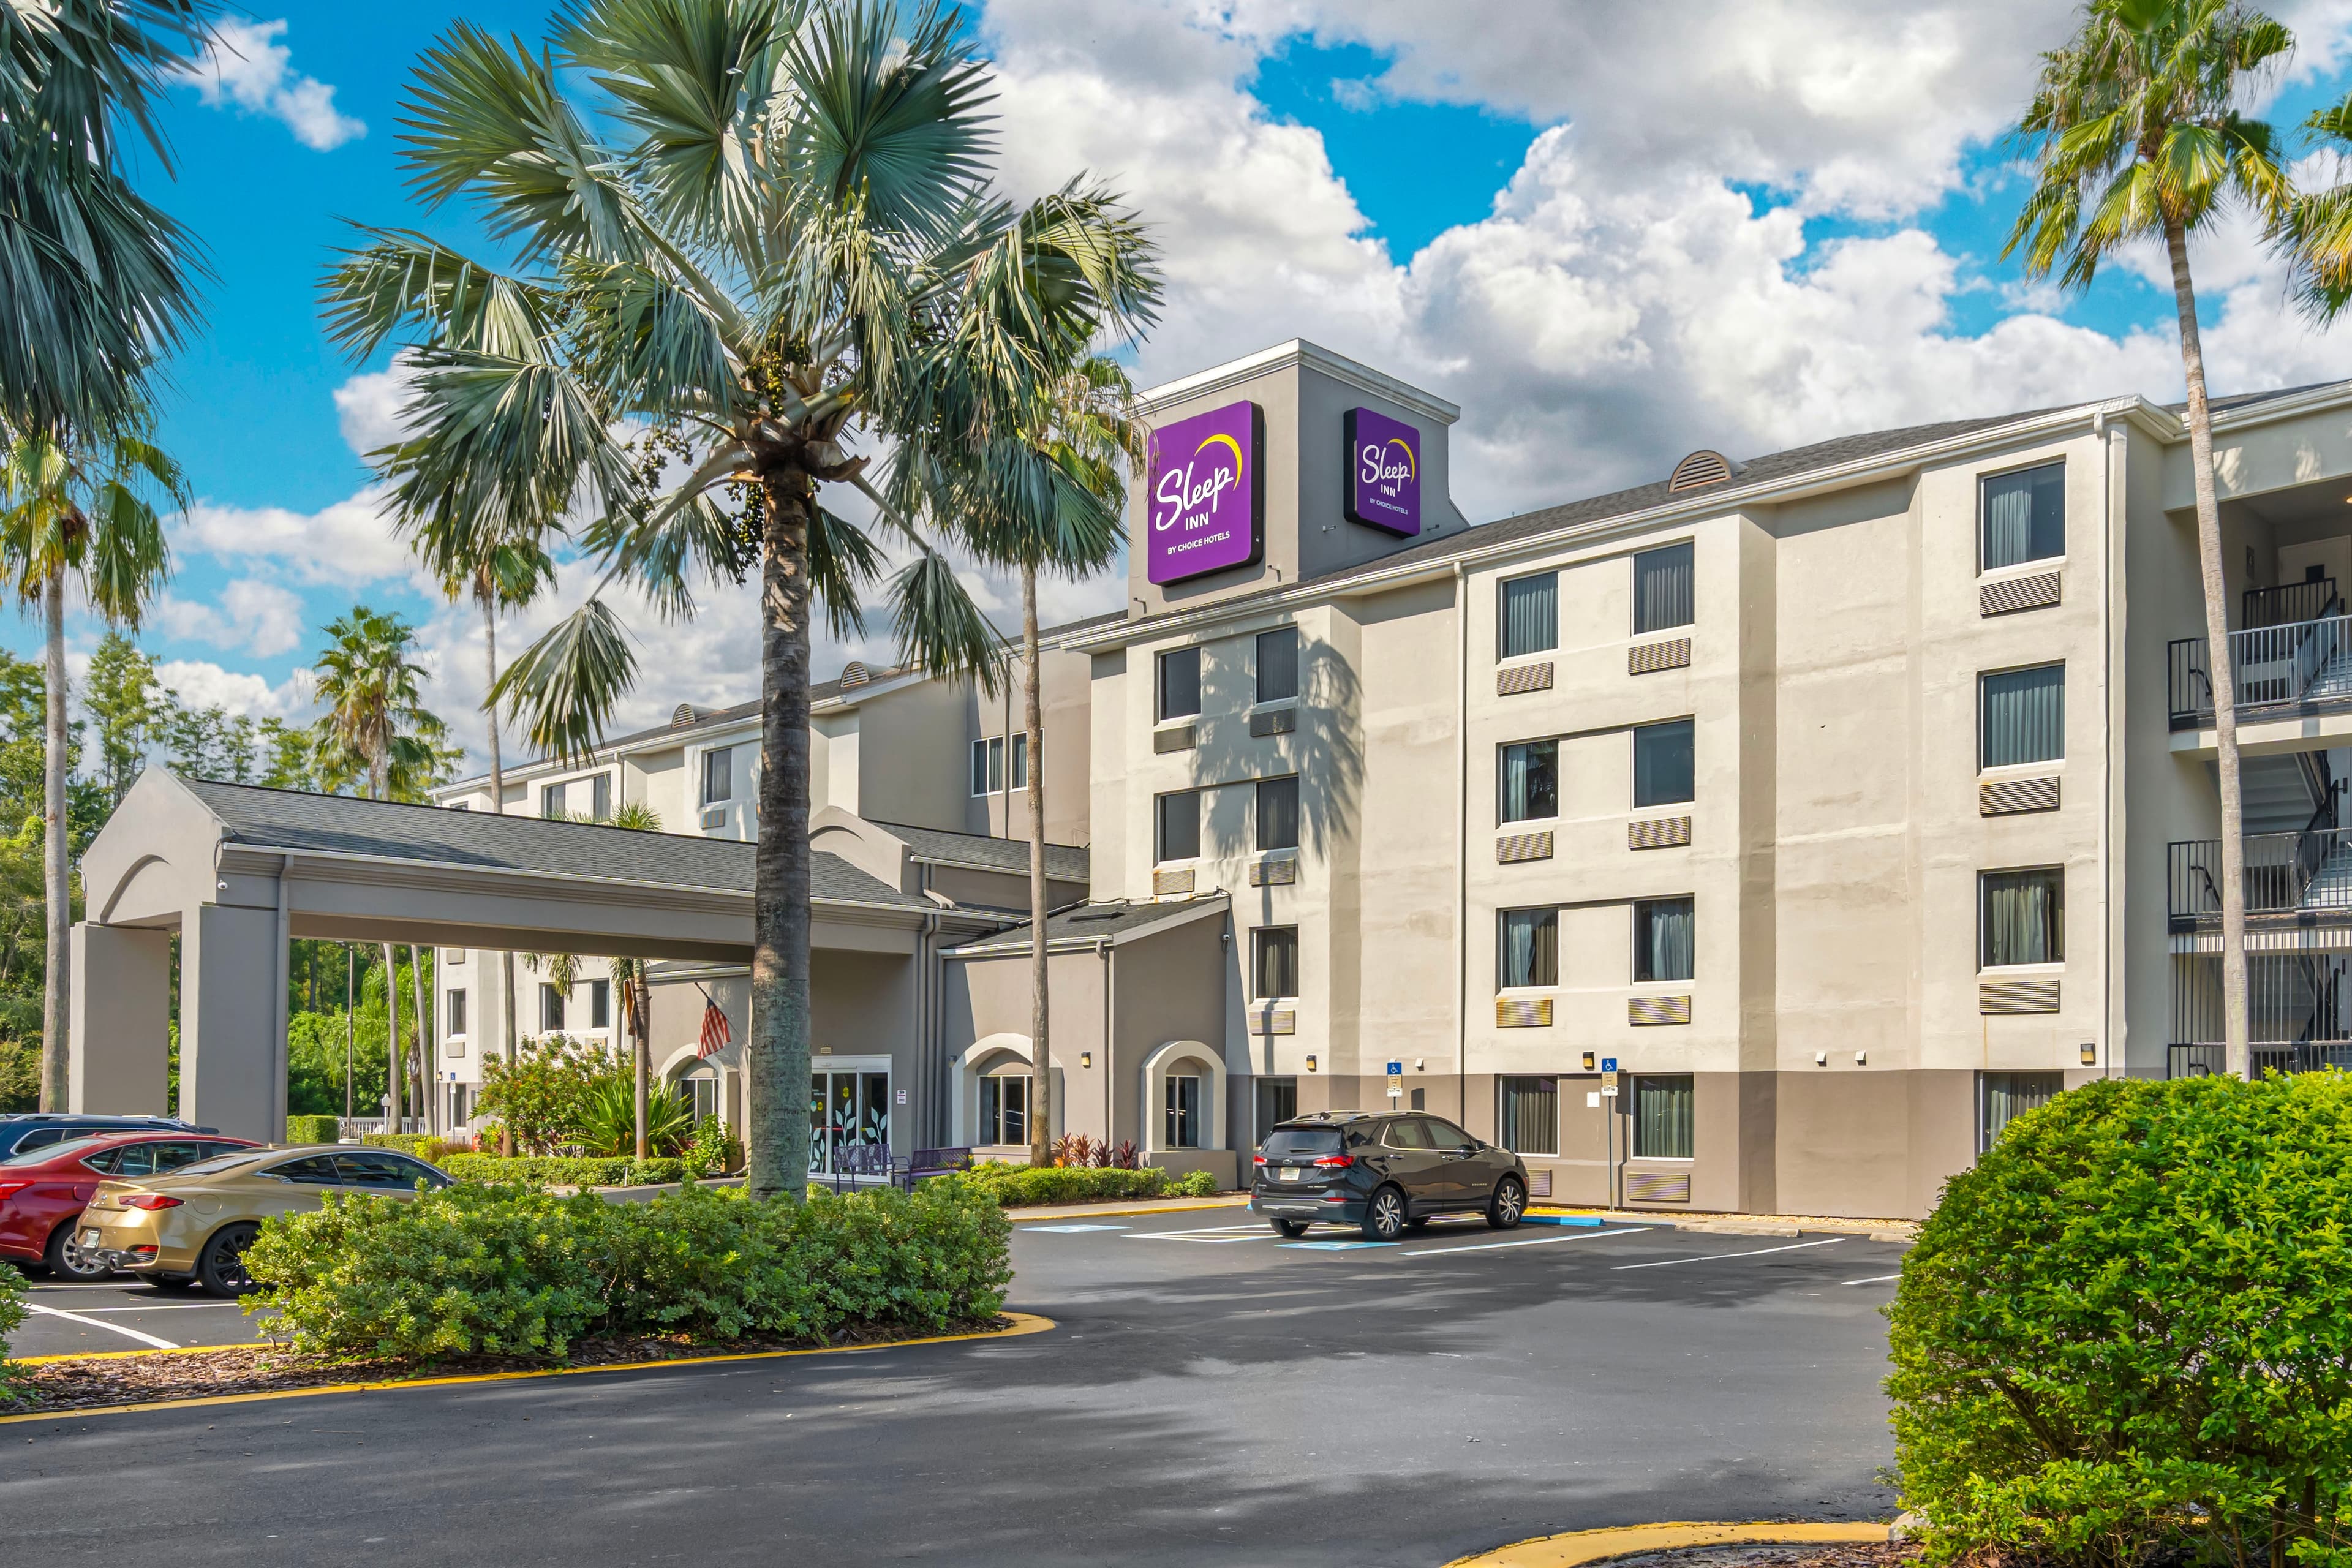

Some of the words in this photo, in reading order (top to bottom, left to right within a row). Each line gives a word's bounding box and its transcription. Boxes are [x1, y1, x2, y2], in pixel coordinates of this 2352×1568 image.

[1362, 444, 1411, 492] Sleep
[1155, 461, 1234, 532] Sleep
[1381, 484, 1396, 497] INN
[1376, 499, 1392, 510] CHOICE
[1392, 504, 1408, 514] HOTELS
[1185, 511, 1209, 531] INN
[1167, 545, 1177, 555] BY
[1177, 538, 1203, 552] CHOICE
[1204, 530, 1231, 545] HOTELS
